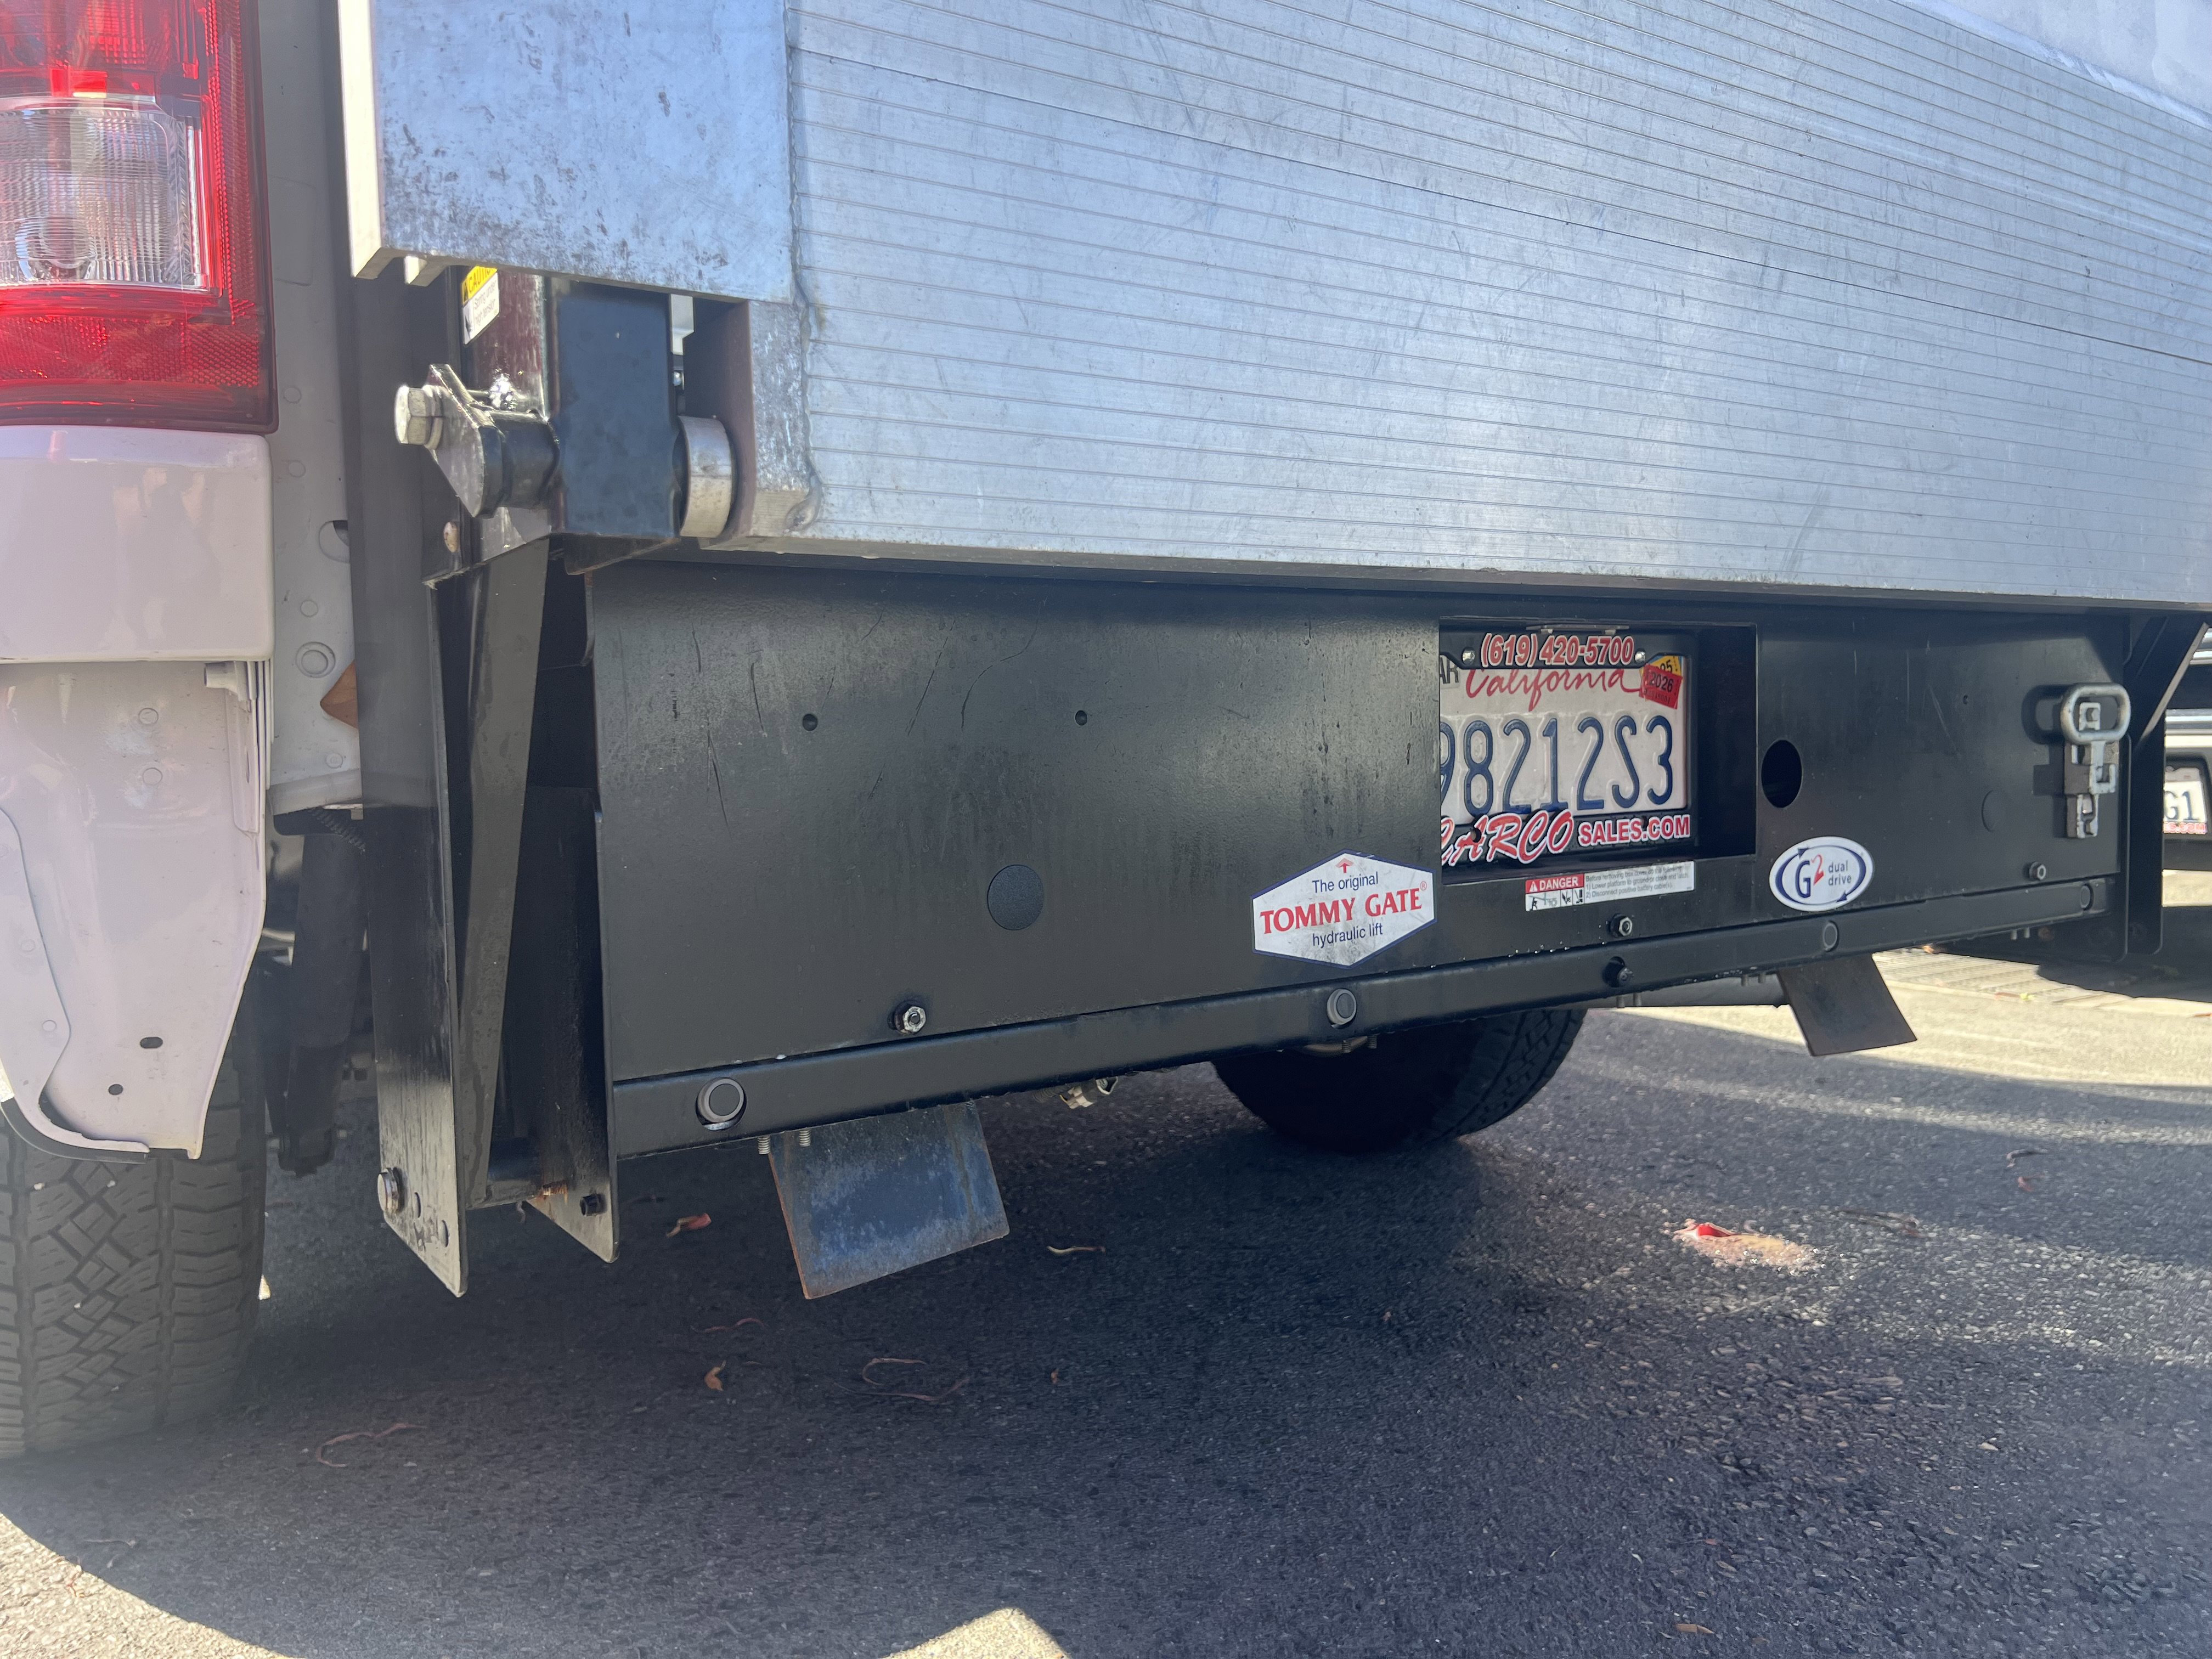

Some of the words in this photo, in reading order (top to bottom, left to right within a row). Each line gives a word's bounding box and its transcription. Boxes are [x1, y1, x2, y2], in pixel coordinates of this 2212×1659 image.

[1481, 633, 1537, 668] (619)
[1539, 635, 1634, 667] 420-5700
[1465, 668, 1641, 712] California
[1649, 672, 1674, 693] 2026
[1578, 814, 1690, 847] SALES.COM
[1828, 860, 1848, 873] dual
[1312, 879, 1334, 894] The
[1338, 871, 1379, 891] original
[1538, 876, 1579, 891] DANGER
[1585, 883, 1591, 891] 1)
[1607, 879, 1626, 888] platform
[1828, 874, 1852, 887] drive
[1585, 891, 1591, 899] 2)
[1592, 889, 1618, 898] Disconnect
[1618, 887, 1636, 896] positive
[1637, 885, 1653, 893] battery
[1260, 897, 1356, 934] TOMMY
[1312, 926, 1366, 949] hydraulic
[1368, 923, 1383, 936] lift
